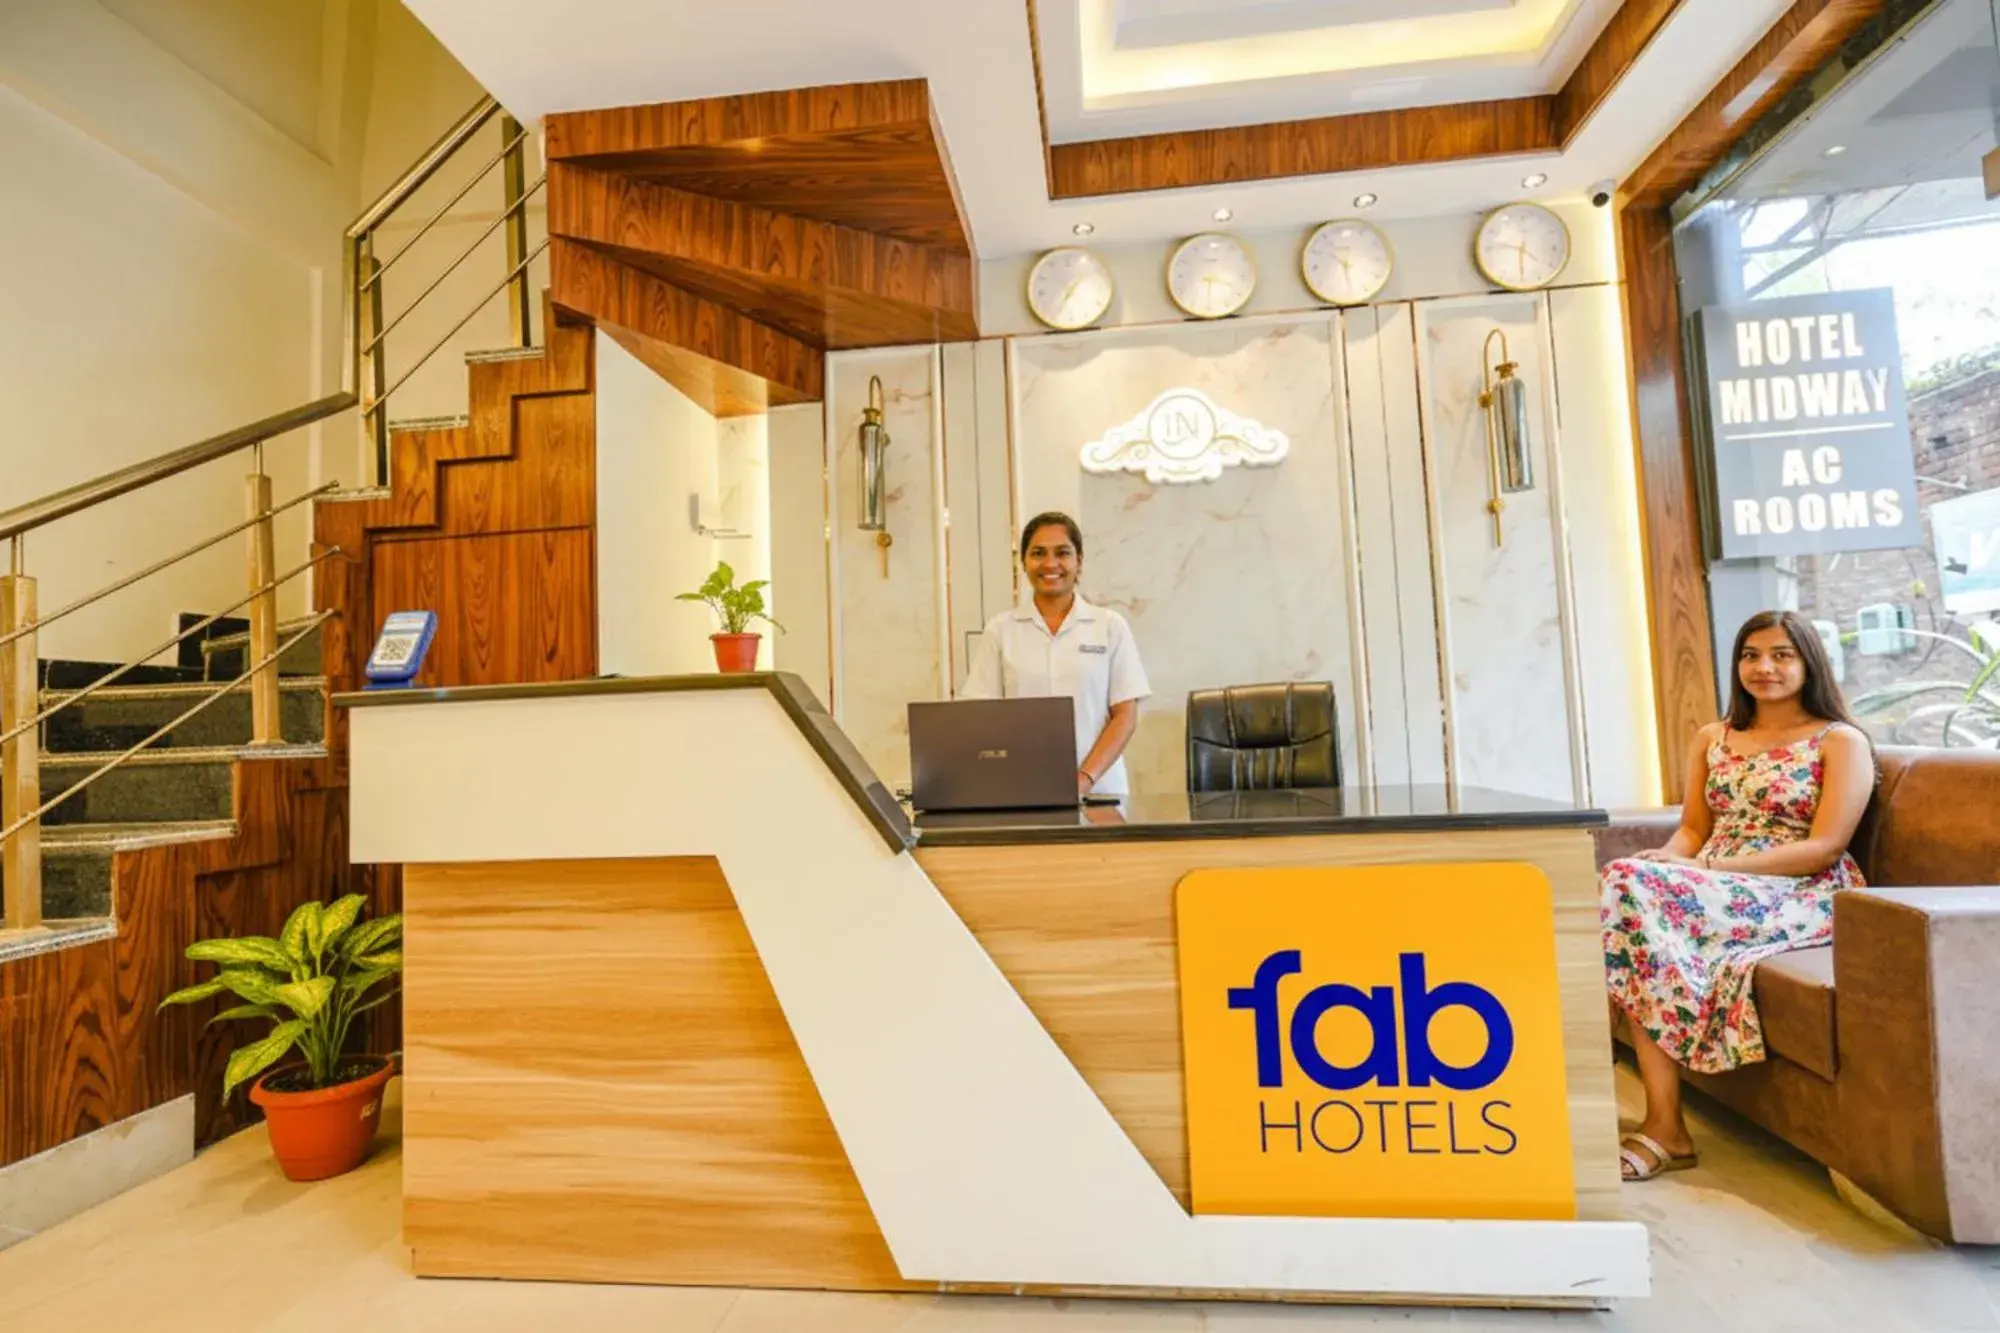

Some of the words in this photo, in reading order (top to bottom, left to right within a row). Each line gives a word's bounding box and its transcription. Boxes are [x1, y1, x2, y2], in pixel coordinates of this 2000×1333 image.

[1736, 312, 1863, 367] HOTEL
[1718, 368, 1888, 424] MIDWAY
[1782, 446, 1842, 487] AC
[1732, 489, 1904, 535] ROOMS
[1227, 949, 1514, 1091] fab
[1259, 1100, 1517, 1155] HOTELS
